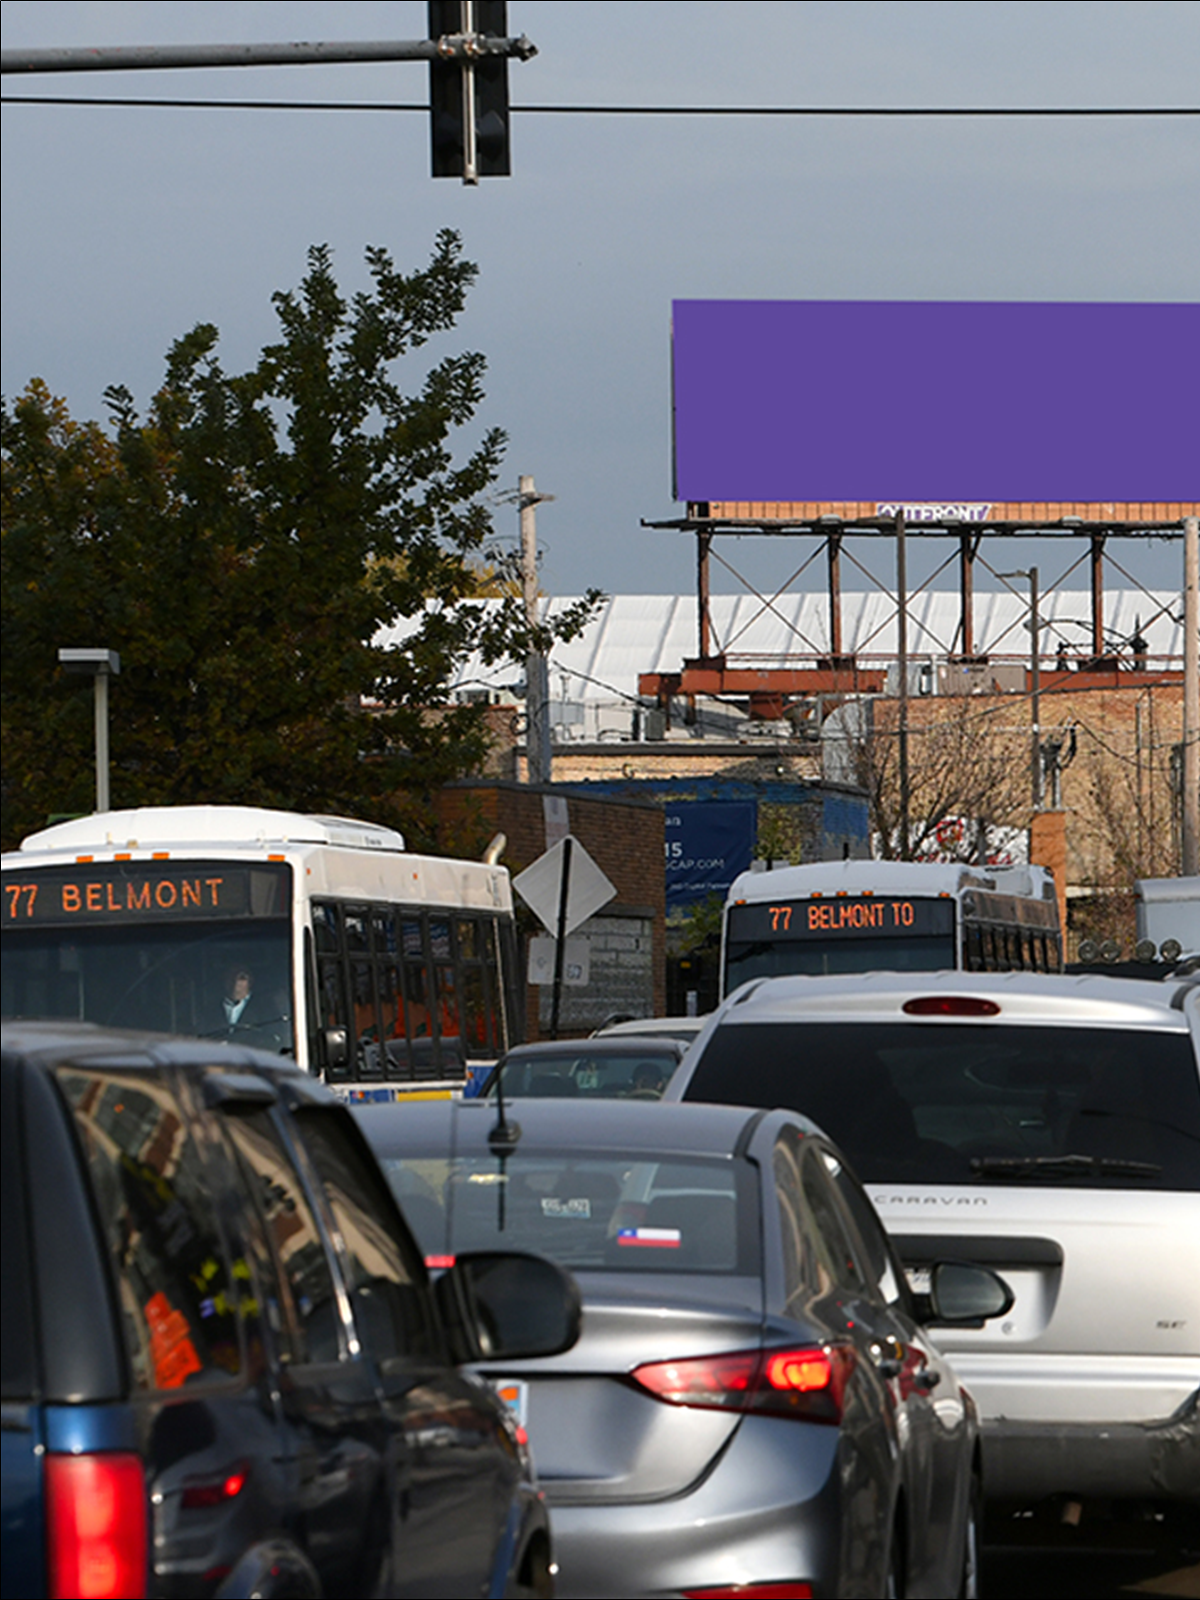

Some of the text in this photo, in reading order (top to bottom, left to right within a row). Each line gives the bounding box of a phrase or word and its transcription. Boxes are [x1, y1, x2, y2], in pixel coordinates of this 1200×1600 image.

[5, 878, 223, 918] 77 BELMONT
[769, 902, 914, 931] 77 BELMONT TO
